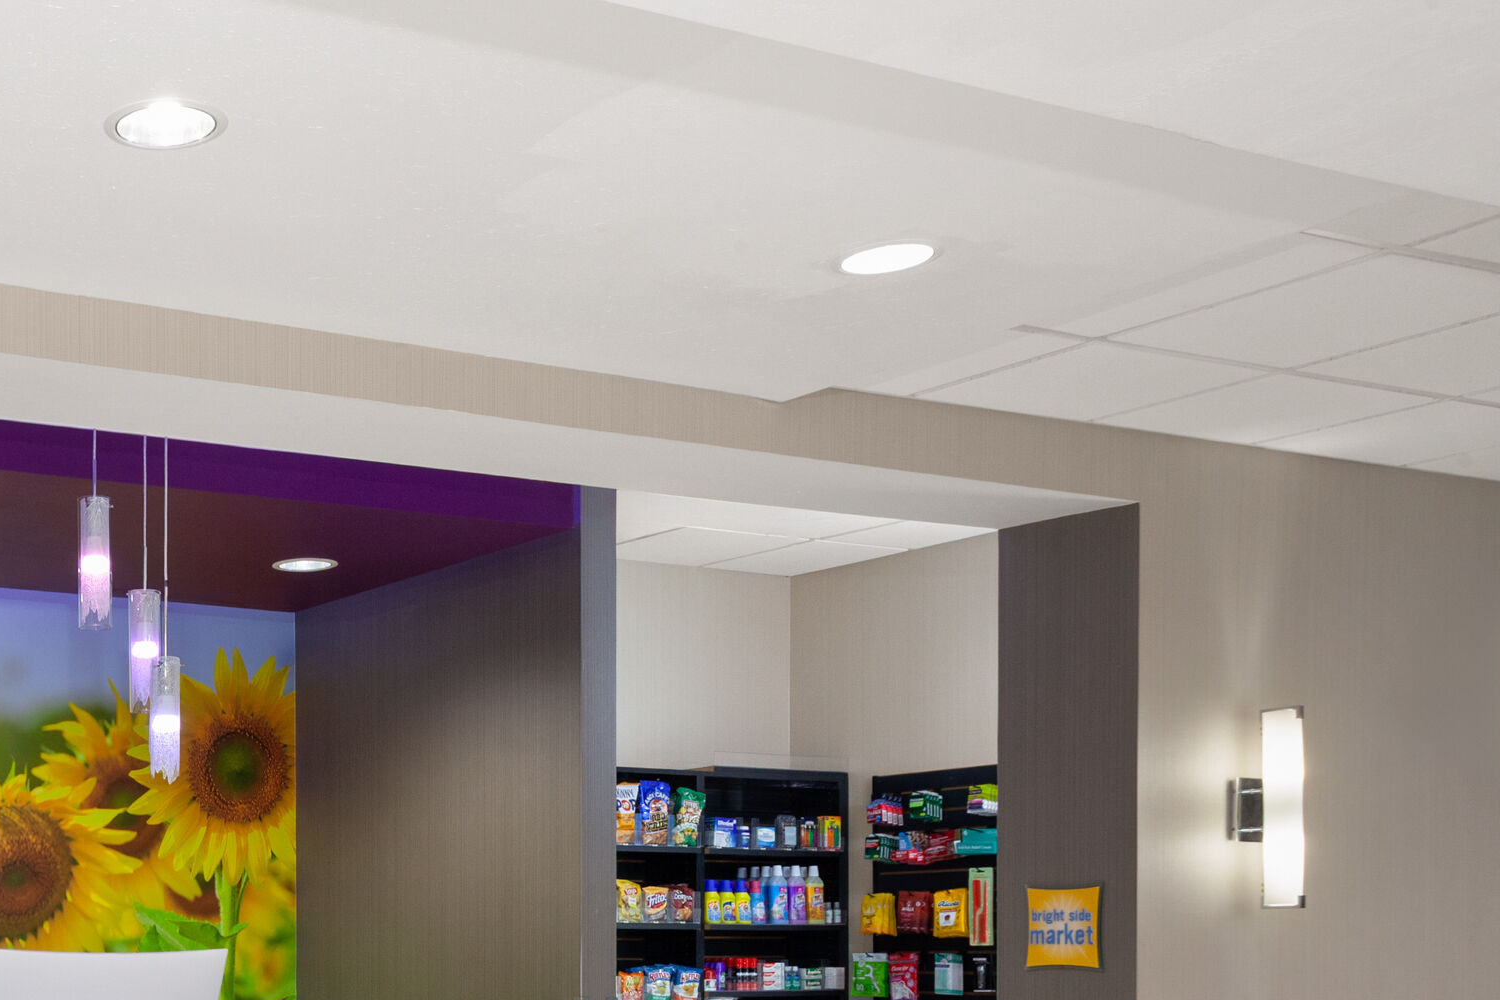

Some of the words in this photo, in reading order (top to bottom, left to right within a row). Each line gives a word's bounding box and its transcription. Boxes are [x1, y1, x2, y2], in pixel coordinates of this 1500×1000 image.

[1031, 908, 1065, 924] bright
[1068, 908, 1092, 922] side
[1030, 923, 1094, 945] market
